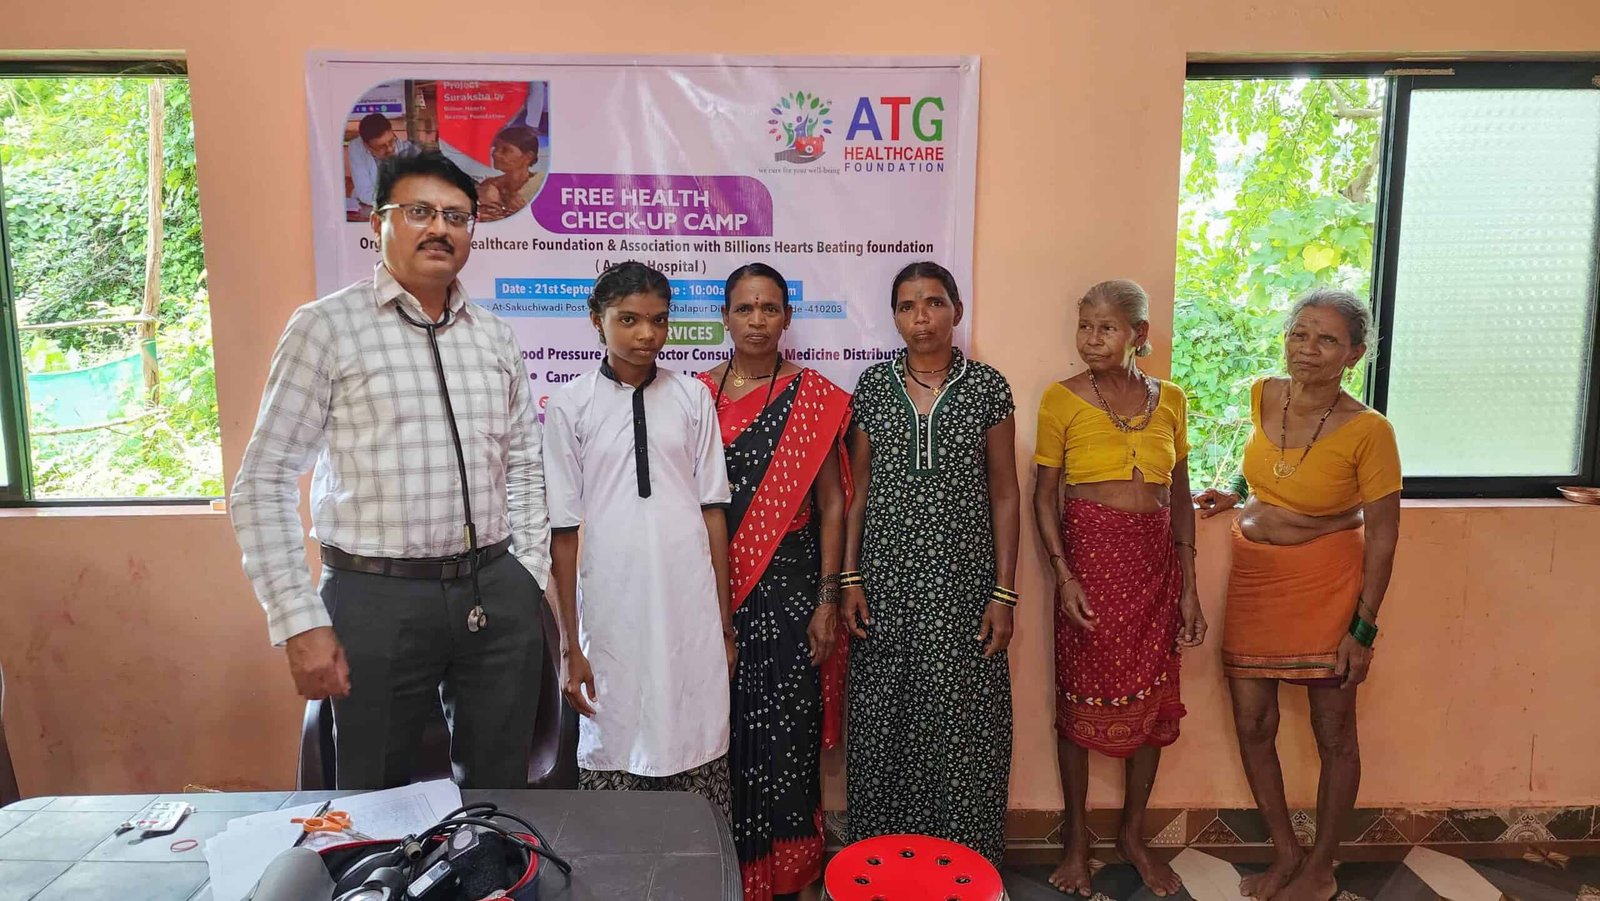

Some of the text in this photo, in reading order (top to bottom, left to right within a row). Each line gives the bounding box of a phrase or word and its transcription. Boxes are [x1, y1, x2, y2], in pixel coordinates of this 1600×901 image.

[845, 96, 944, 142] ATG
[844, 147, 944, 161] HEALTHCARE
[844, 162, 944, 173] FOUNDATION
[561, 187, 709, 208] FREE HEALTH
[561, 210, 748, 231] CHECK-UP CAMP
[471, 237, 529, 251] ealthcare
[532, 237, 604, 251] Foundation
[607, 239, 617, 251] &
[620, 239, 690, 253] Association
[693, 240, 721, 253] with
[724, 240, 771, 253] Billions
[774, 241, 814, 254] Hearts
[817, 241, 864, 257] Beating
[867, 240, 934, 253] foundation
[647, 259, 699, 276] Hospital
[502, 283, 526, 294] Date
[535, 283, 559, 295] 21st
[689, 284, 725, 296] 10:00a
[492, 303, 563, 312] At-Sakuchiwadi
[565, 303, 589, 312] Post-
[668, 326, 714, 341] RVICES
[522, 347, 903, 361] ood Pressure octor Consul Medicine Distributi
